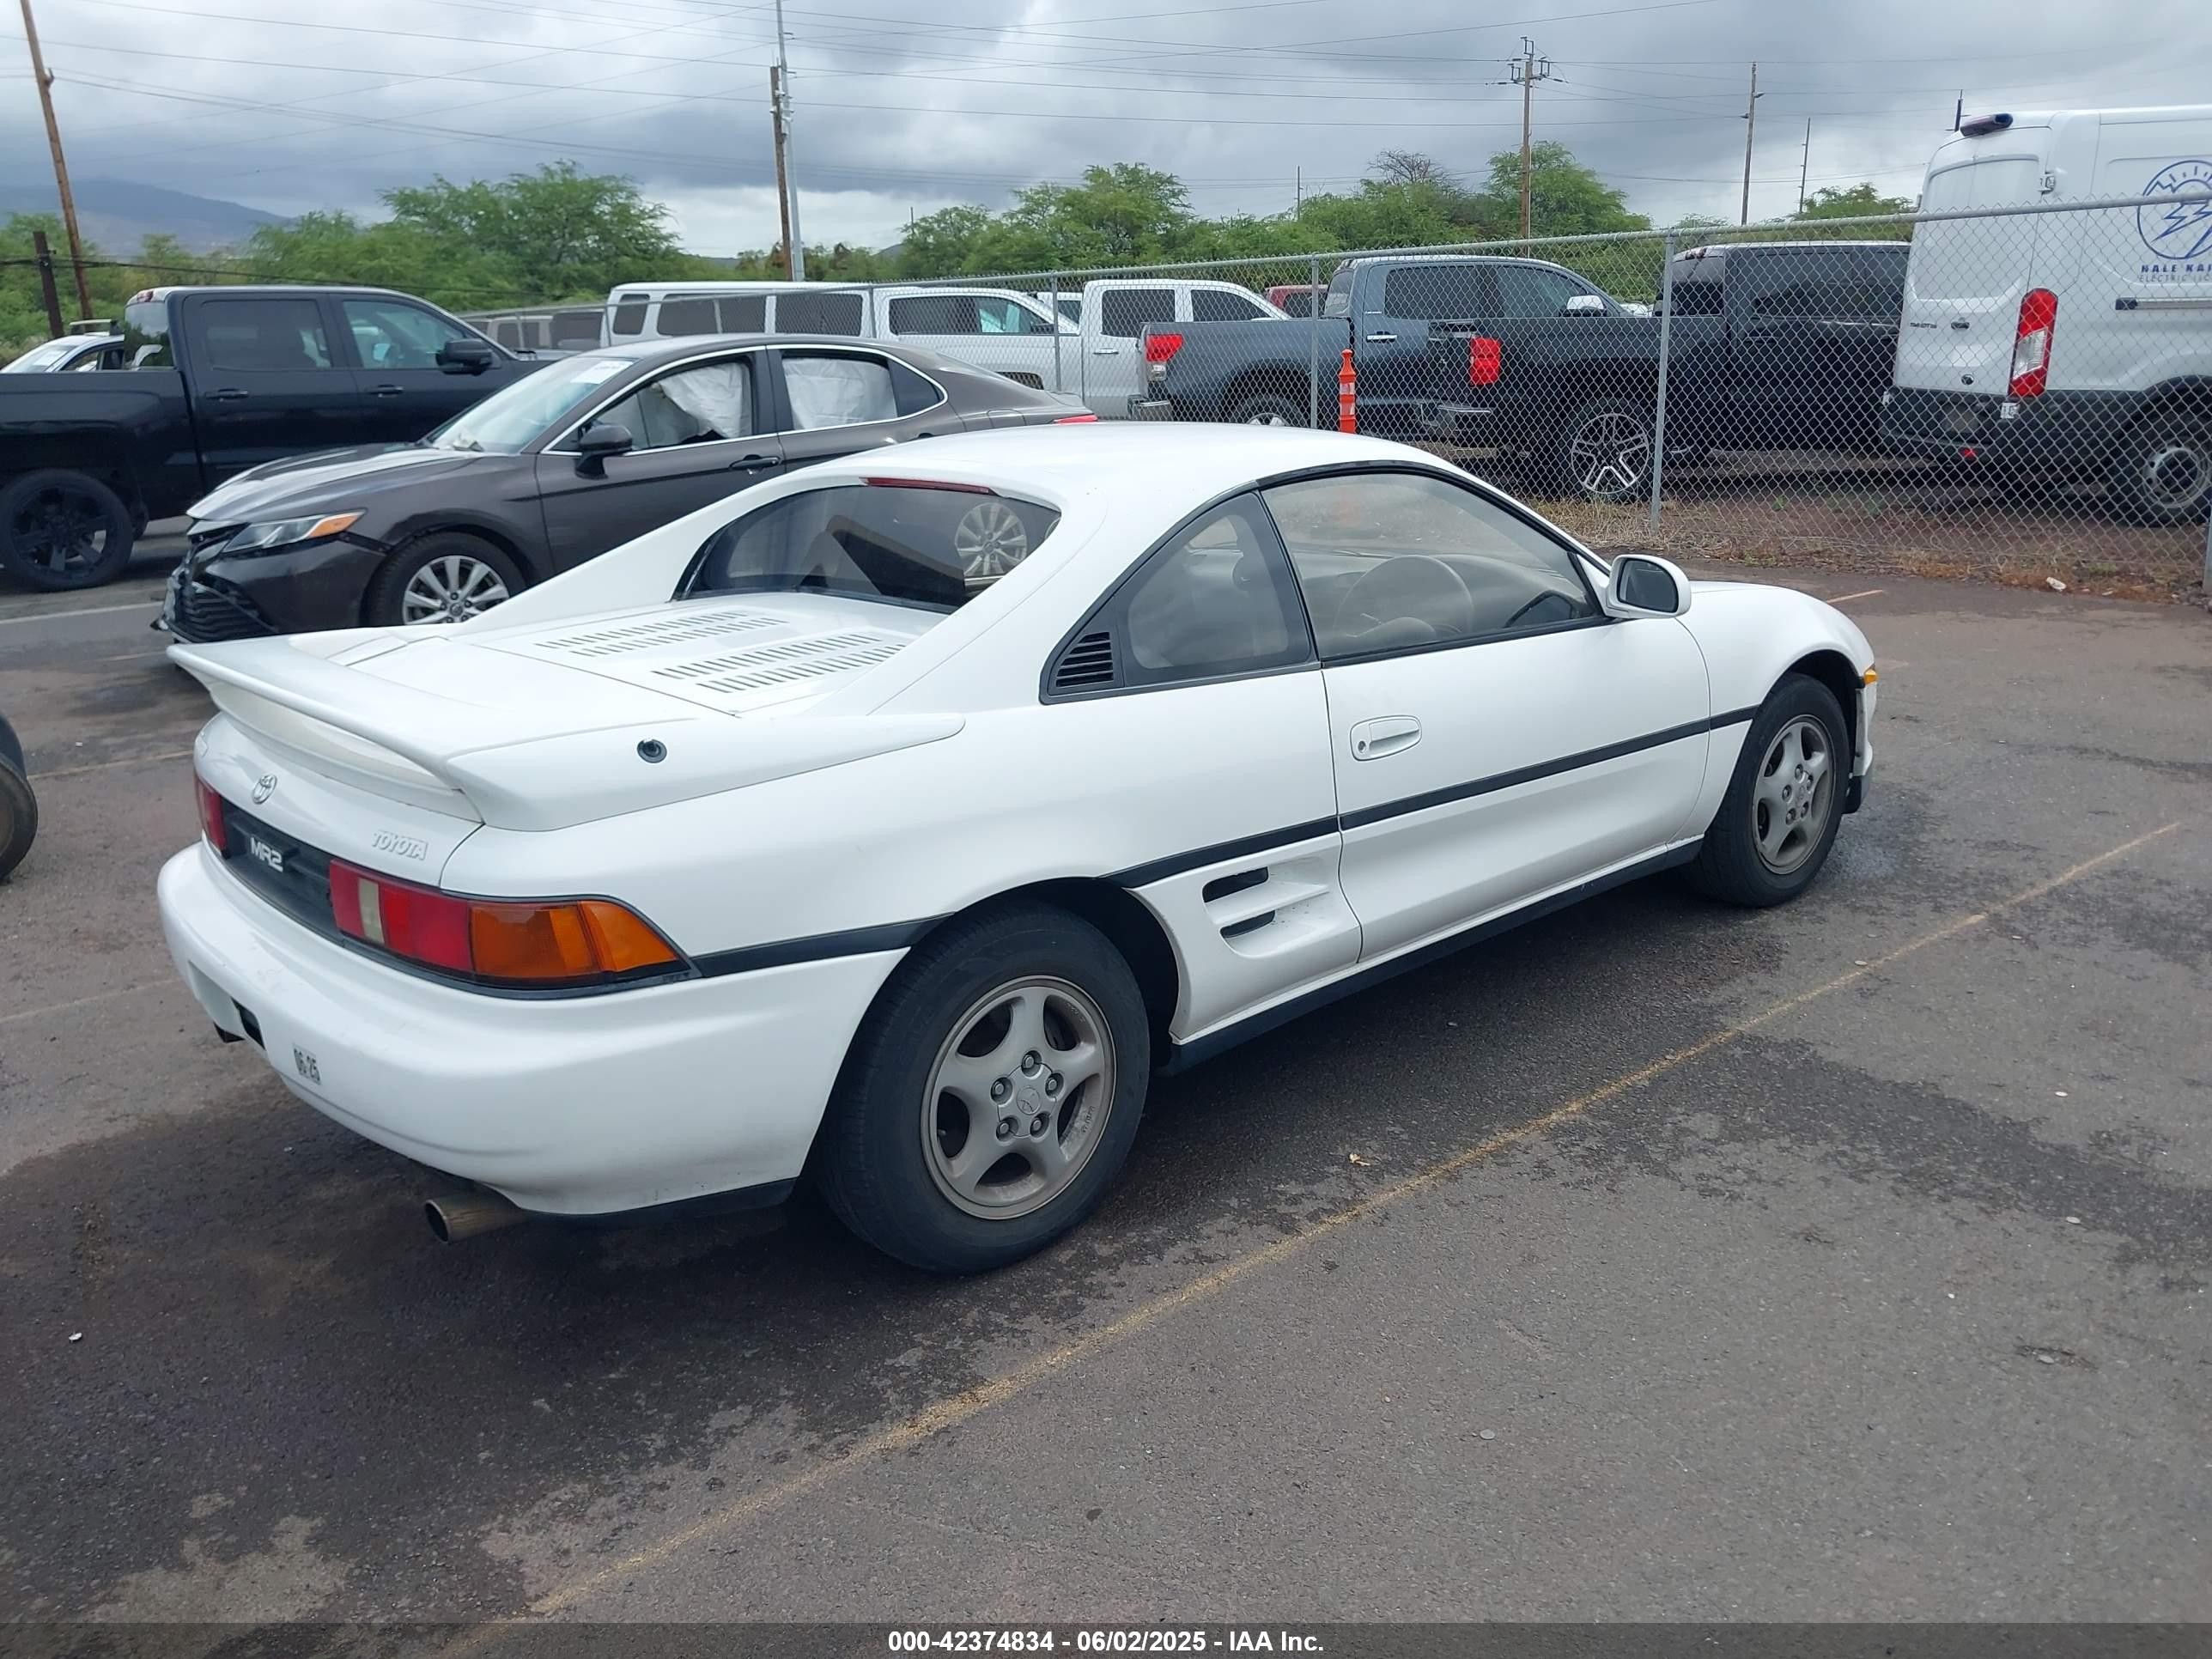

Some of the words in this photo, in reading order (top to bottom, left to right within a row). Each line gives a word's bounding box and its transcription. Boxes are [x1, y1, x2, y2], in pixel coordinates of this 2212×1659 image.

[2141, 264, 2178, 273] HALE
[250, 836, 283, 873] MR2
[371, 830, 428, 860] TOYOTA
